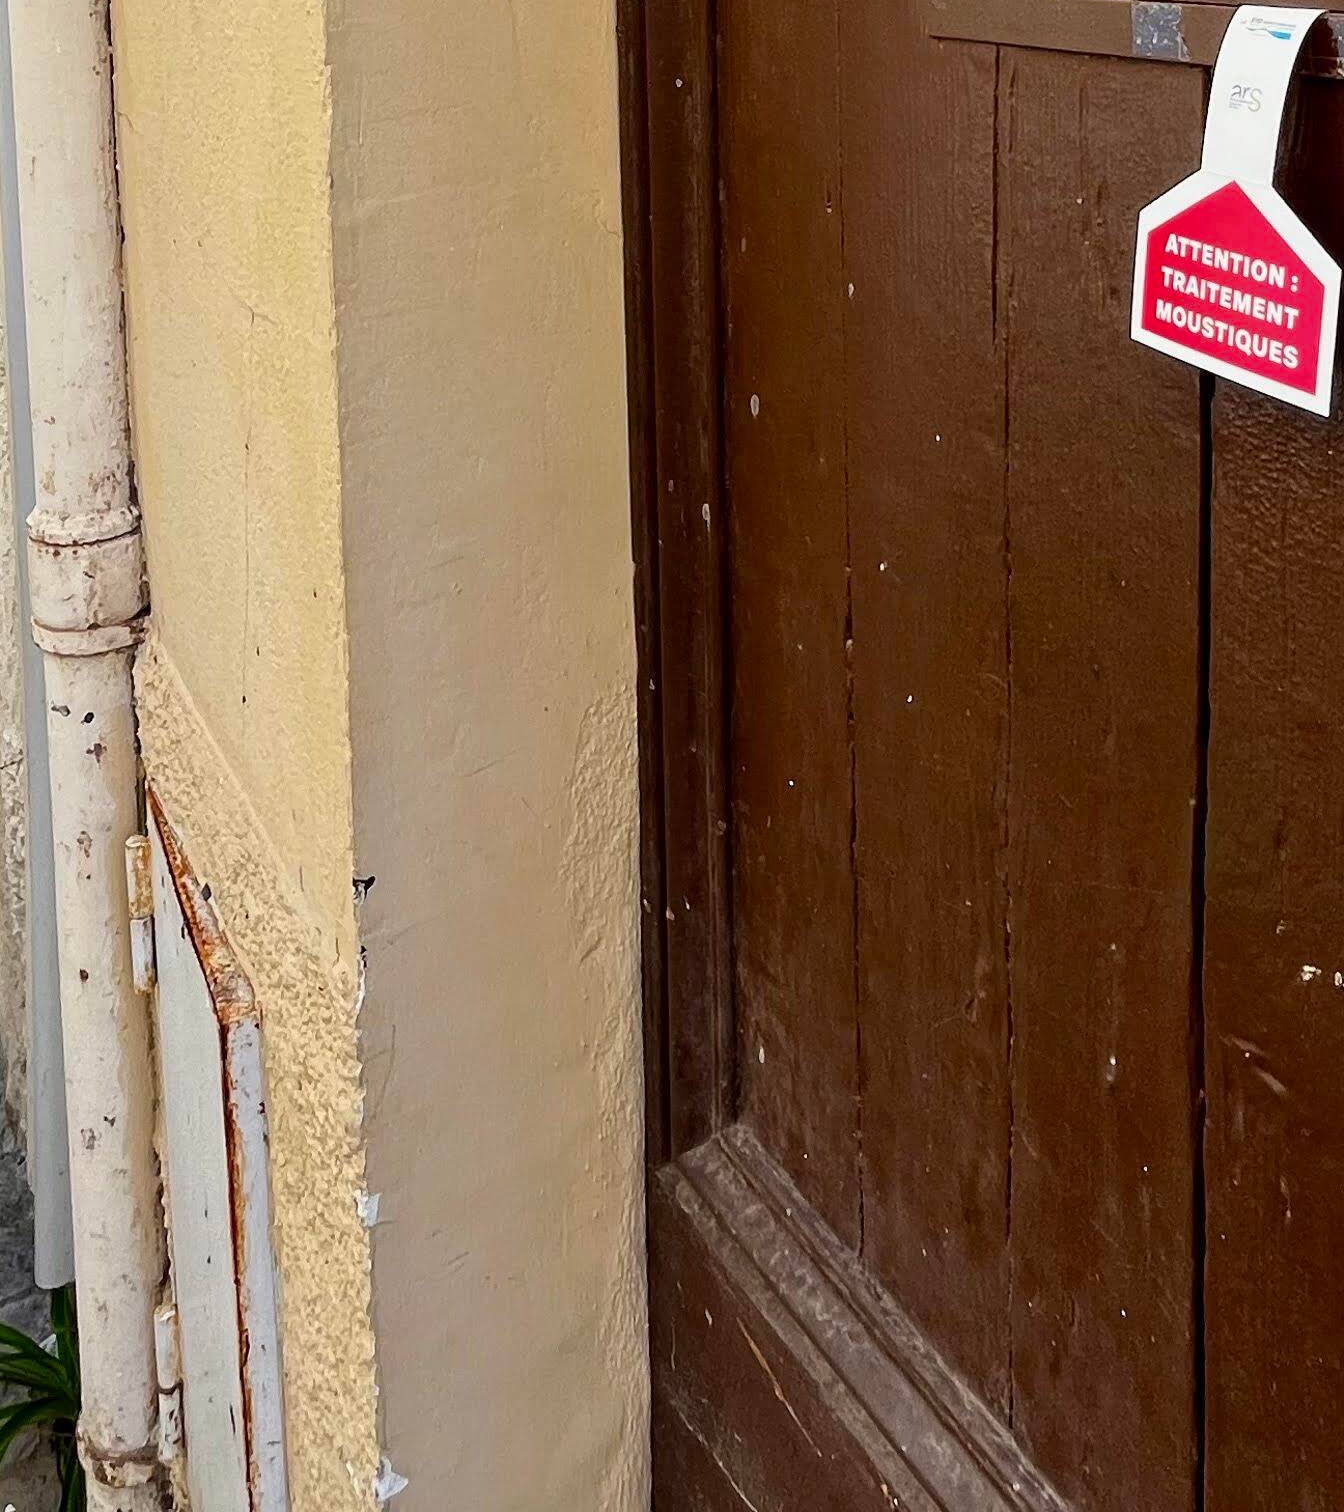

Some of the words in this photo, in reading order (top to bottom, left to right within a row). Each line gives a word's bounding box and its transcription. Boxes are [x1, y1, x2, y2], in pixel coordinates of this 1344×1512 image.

[1164, 233, 1286, 289] ATTENTION
[1160, 265, 1300, 330] TRAITEMENT
[1155, 298, 1299, 370] MOUSTIQUES
